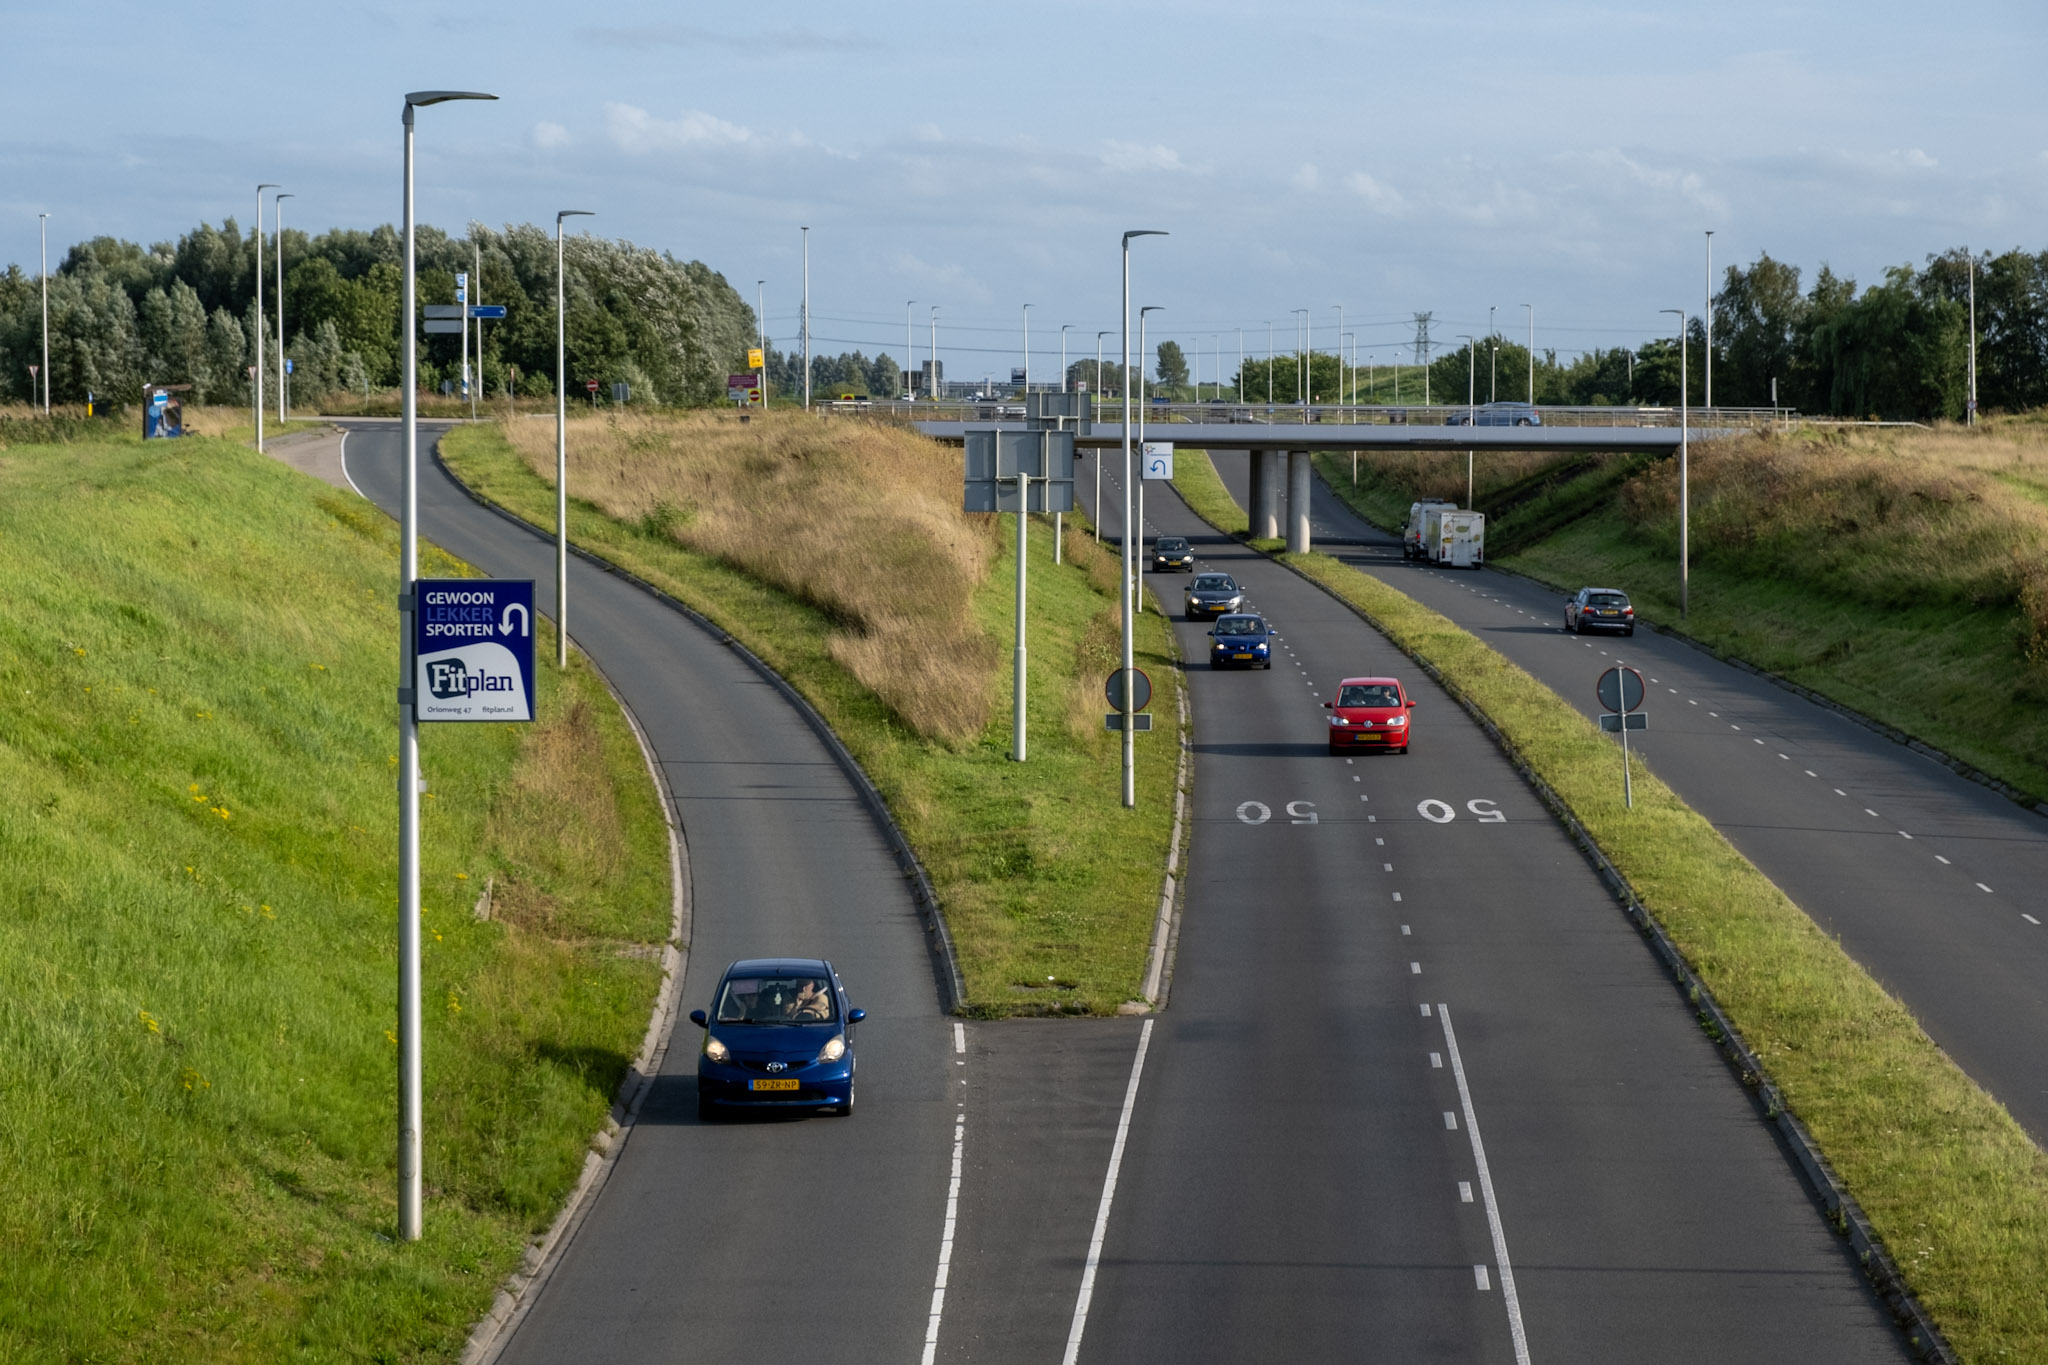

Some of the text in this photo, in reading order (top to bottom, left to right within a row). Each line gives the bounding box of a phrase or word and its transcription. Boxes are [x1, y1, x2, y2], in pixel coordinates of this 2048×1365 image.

[425, 592, 494, 605] GEWOON
[426, 607, 494, 622] LEKKER
[425, 624, 494, 636] SPORTEN
[431, 664, 514, 699] Fitplan
[427, 706, 514, 715] Orionweg 47 fitplan.nl
